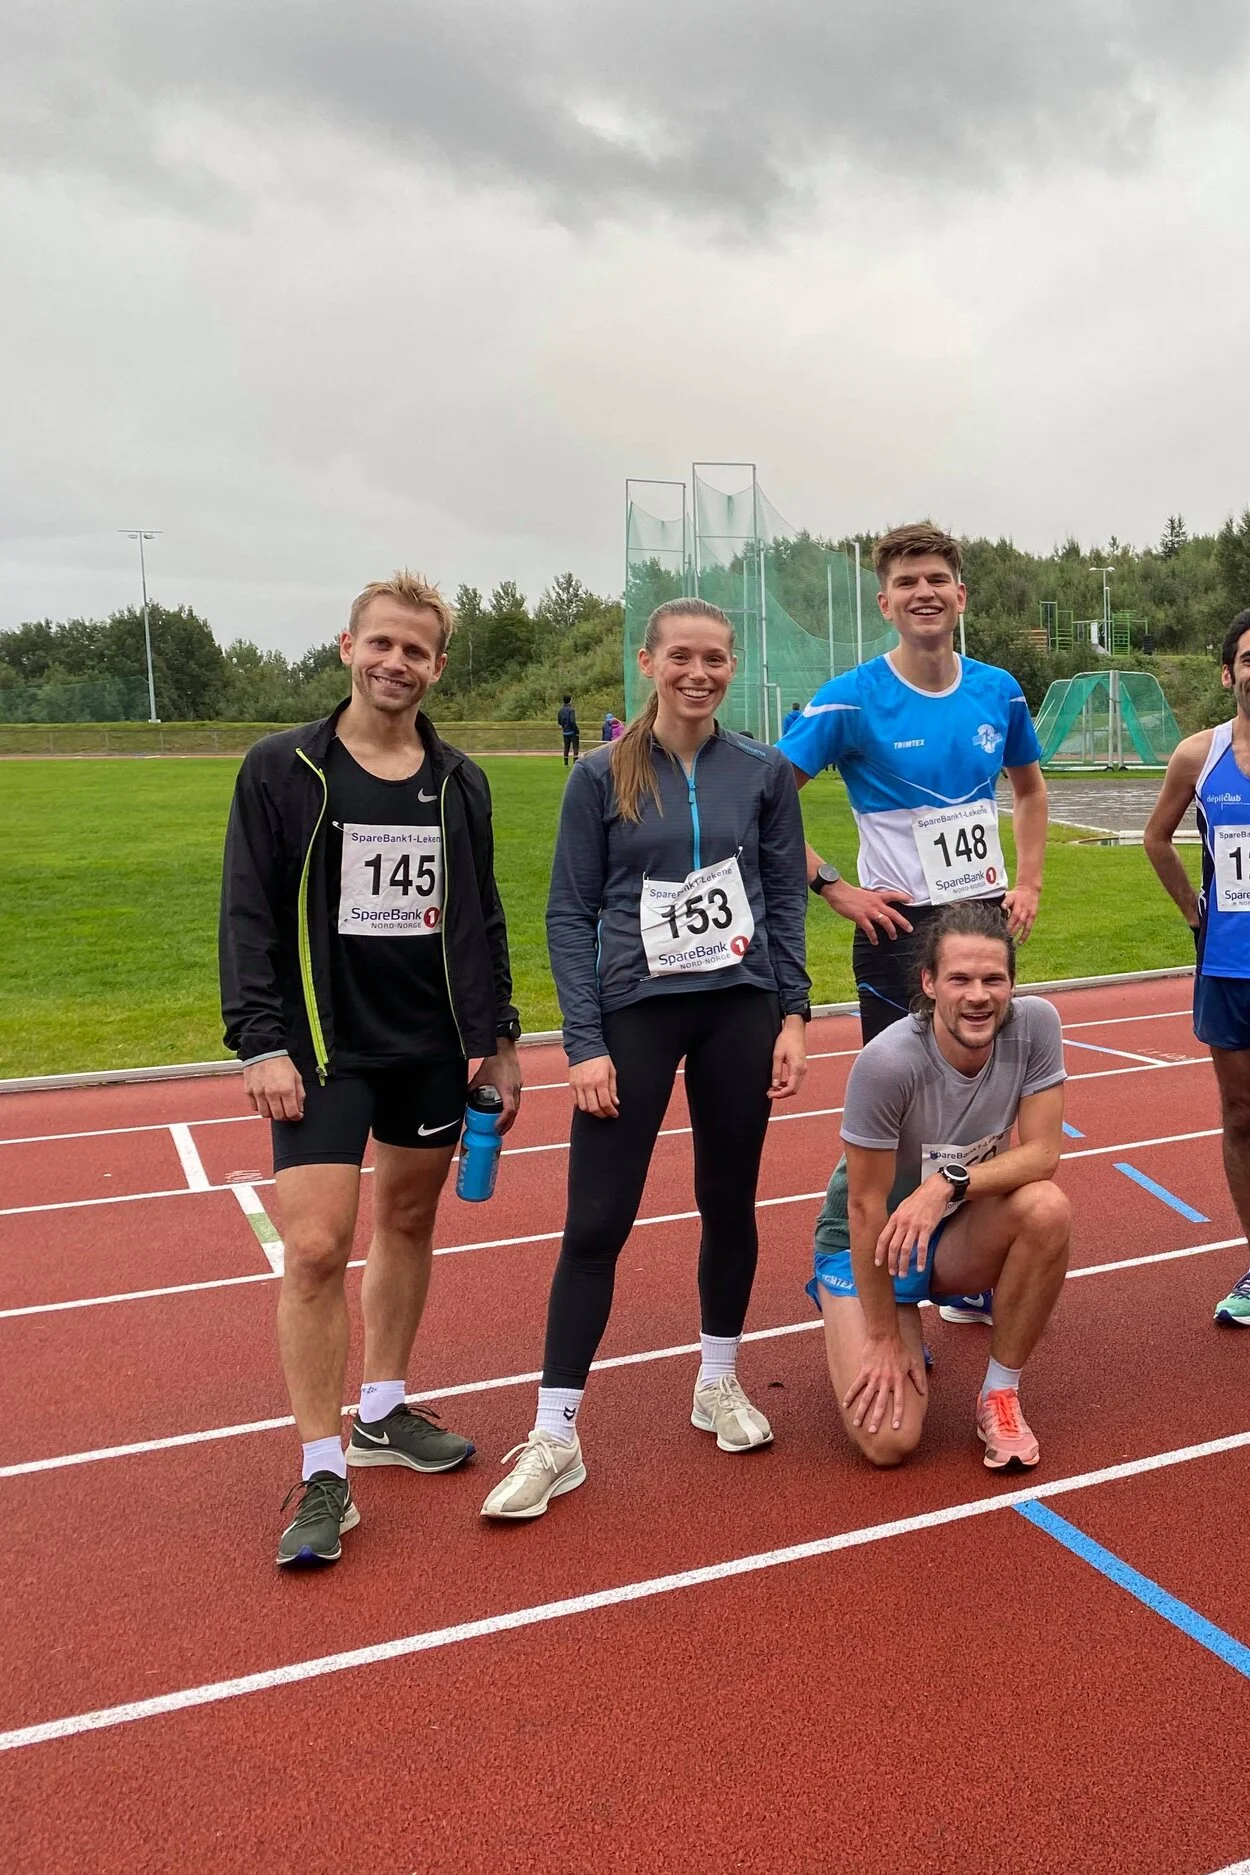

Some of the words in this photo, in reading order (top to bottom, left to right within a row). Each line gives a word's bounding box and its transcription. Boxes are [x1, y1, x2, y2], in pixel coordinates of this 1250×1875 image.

[893, 738, 925, 749] TRIMTEX
[917, 808, 988, 828] SpareBank1-Lekene
[351, 832, 441, 843] SpareBank1-Leken
[933, 824, 988, 868] 148
[364, 853, 436, 897] 145
[935, 871, 985, 891] SpareBank
[351, 907, 422, 921] SpareBank
[661, 888, 733, 939] 153
[658, 942, 728, 965] SpareBank
[679, 953, 731, 970] NORD-NORGE
